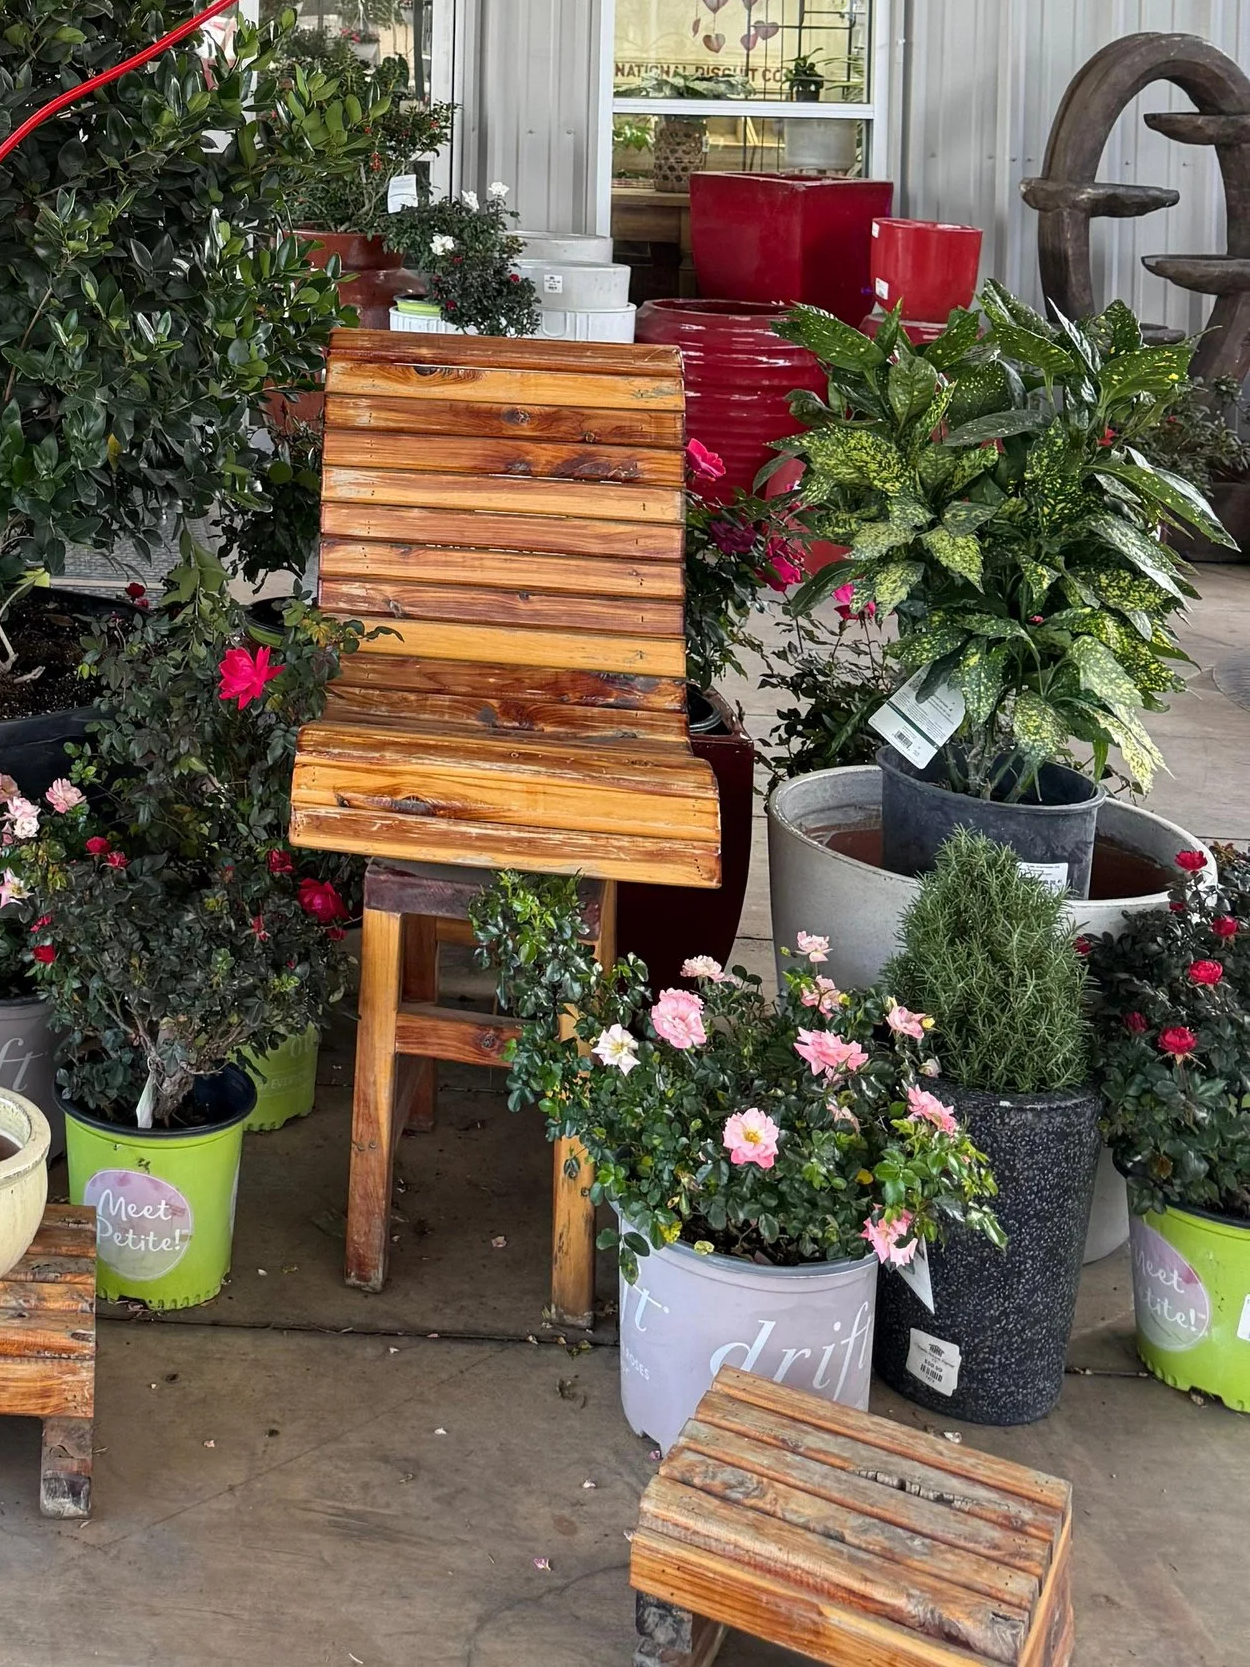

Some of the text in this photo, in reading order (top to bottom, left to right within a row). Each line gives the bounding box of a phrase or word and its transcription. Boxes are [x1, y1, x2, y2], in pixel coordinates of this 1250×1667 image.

[97, 1188, 172, 1222] Meet
[96, 1215, 181, 1252] Petite!
[1140, 1287, 1197, 1332] tite!
